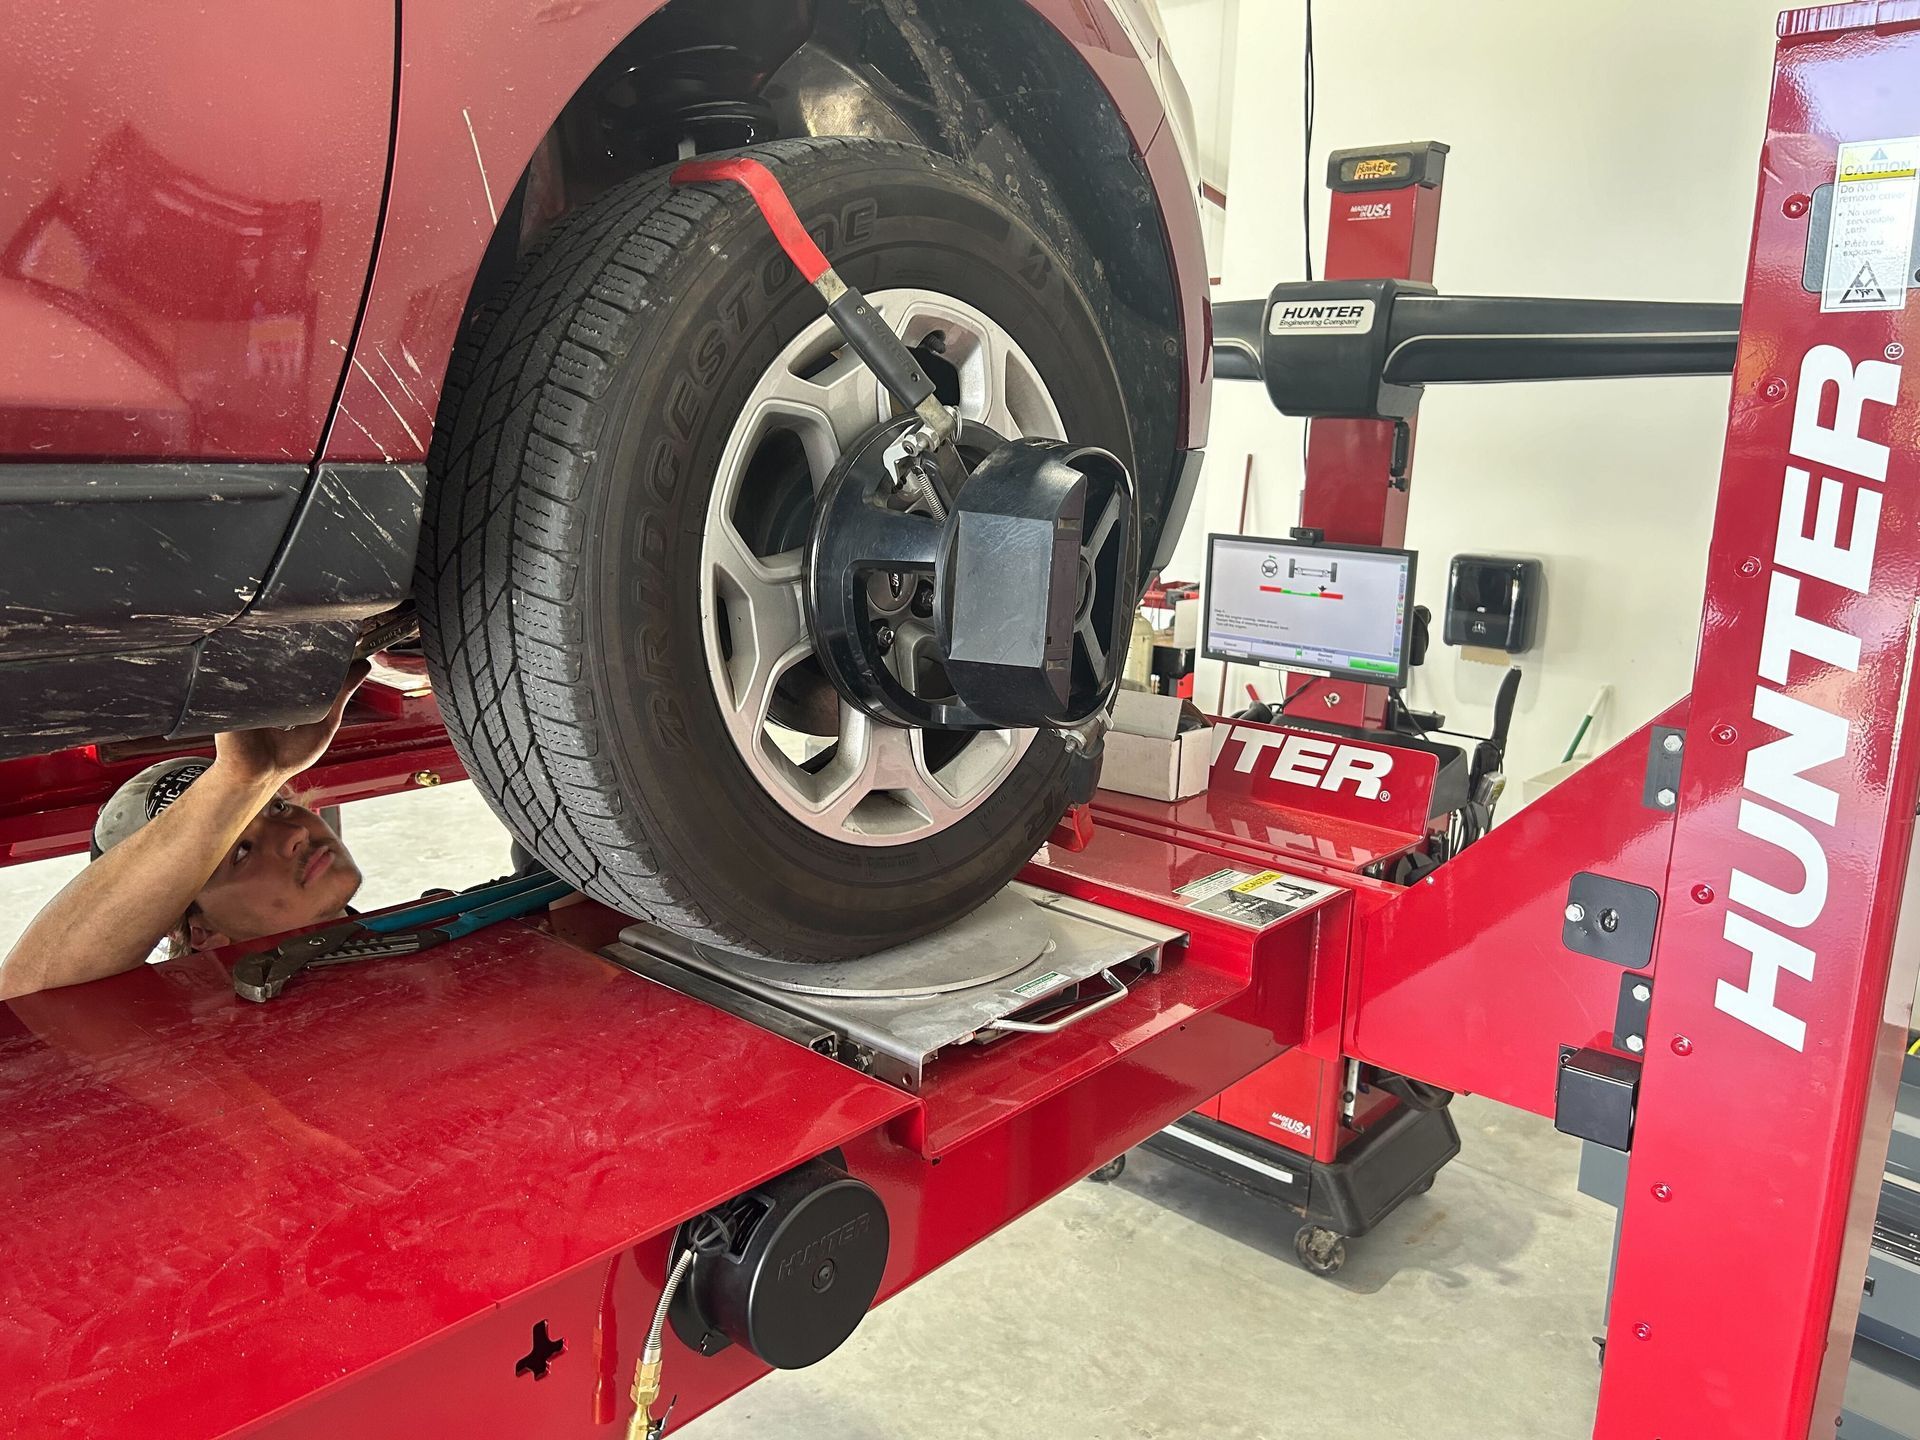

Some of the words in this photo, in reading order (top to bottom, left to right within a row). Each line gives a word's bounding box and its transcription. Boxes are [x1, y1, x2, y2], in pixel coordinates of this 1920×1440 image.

[1845, 160, 1911, 176] CAUTION
[1841, 184, 1855, 194] Do
[1857, 181, 1879, 193] NOT
[1366, 203, 1391, 217] USA
[1282, 306, 1364, 319] HUNTER
[1323, 318, 1360, 326] Company
[1287, 1118, 1312, 1137] USA
